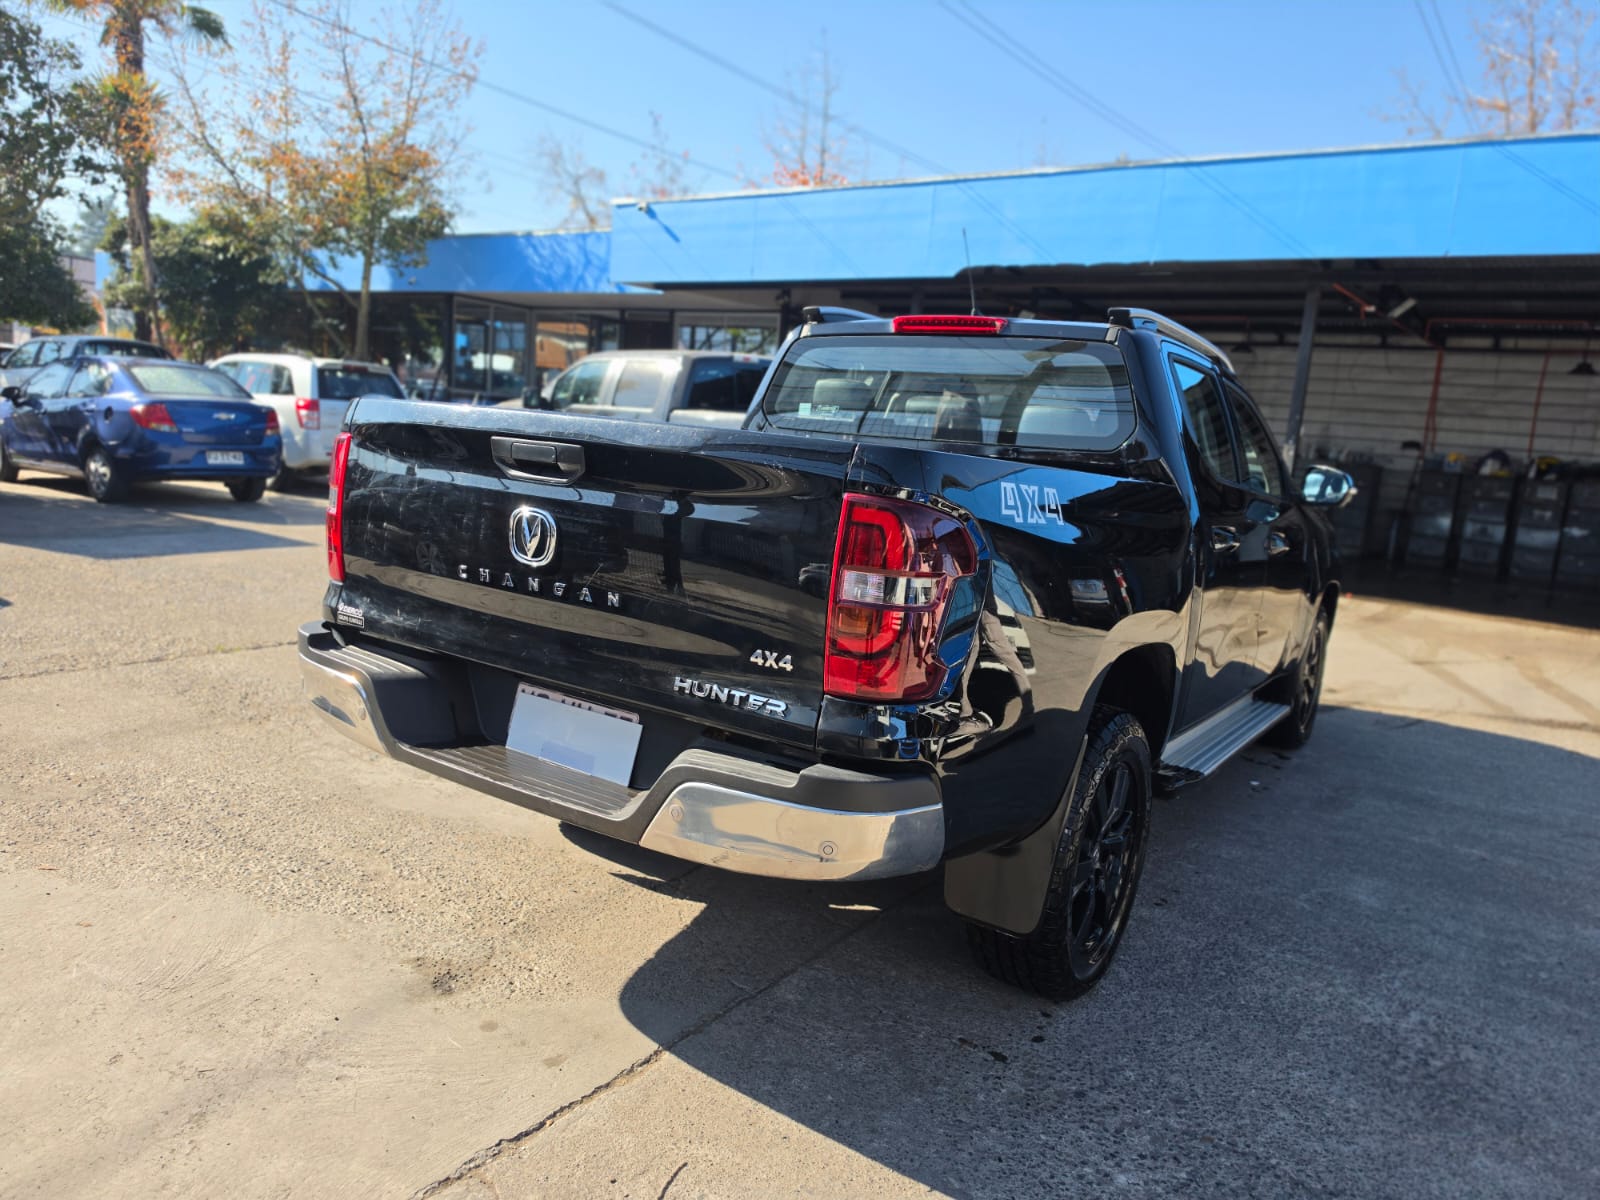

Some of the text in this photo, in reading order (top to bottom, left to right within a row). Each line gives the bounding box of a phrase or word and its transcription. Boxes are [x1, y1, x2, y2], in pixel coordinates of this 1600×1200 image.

[1000, 481, 1065, 526] 4X4
[458, 564, 620, 607] CHANGAN
[749, 649, 793, 672] 4X4
[673, 676, 787, 718] HUNTER
